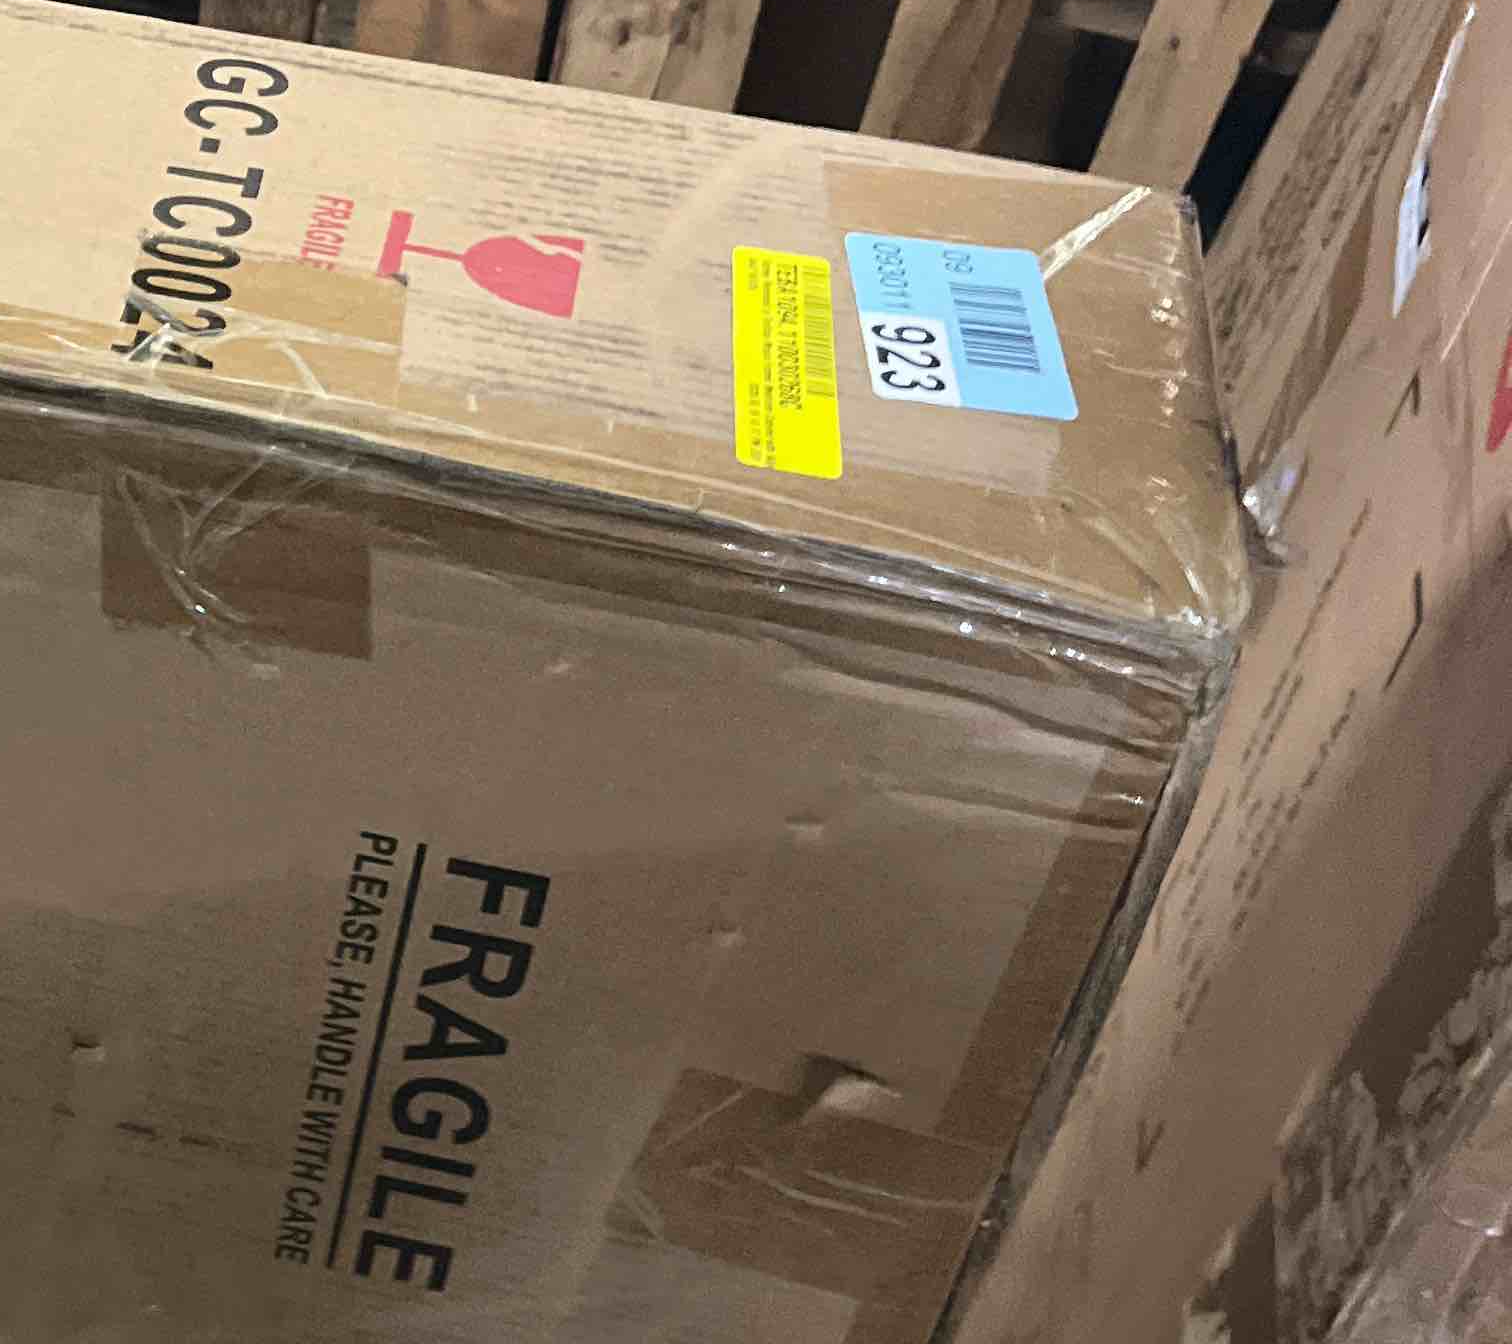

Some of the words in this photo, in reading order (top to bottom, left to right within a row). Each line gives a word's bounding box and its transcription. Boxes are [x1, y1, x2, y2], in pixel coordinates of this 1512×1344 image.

[871, 323, 947, 393] 923
[328, 830, 399, 967] PLEASE,
[306, 976, 366, 1108] HANDLE
[354, 857, 551, 1292] FRAGILE
[291, 1108, 338, 1184] WITH
[274, 1186, 321, 1266] CARE
